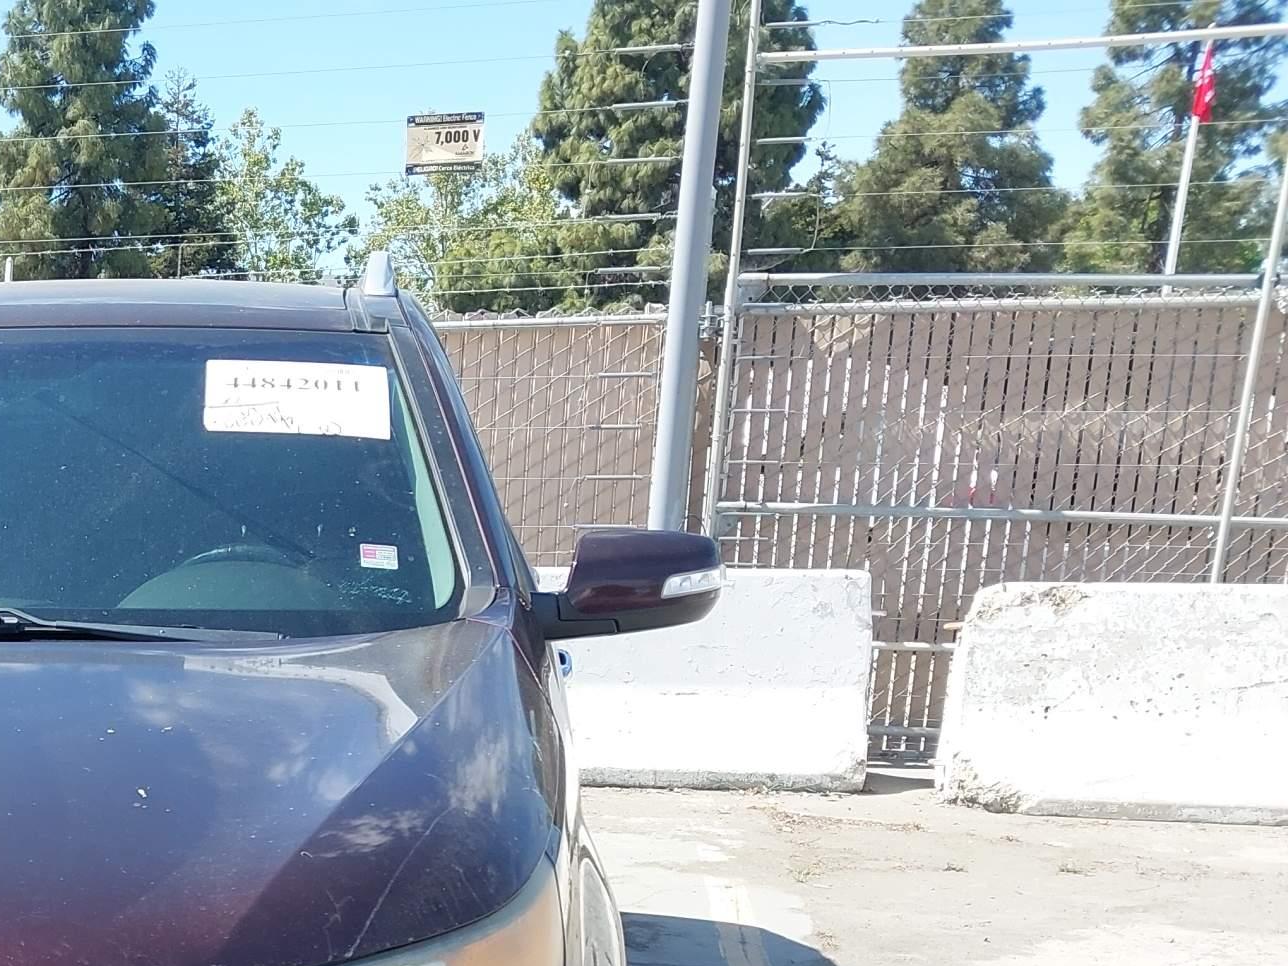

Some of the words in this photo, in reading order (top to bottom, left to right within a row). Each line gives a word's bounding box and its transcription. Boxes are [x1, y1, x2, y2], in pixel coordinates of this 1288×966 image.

[435, 129, 469, 146] 7,000
[472, 128, 481, 142] V
[225, 376, 362, 393] 44842011
